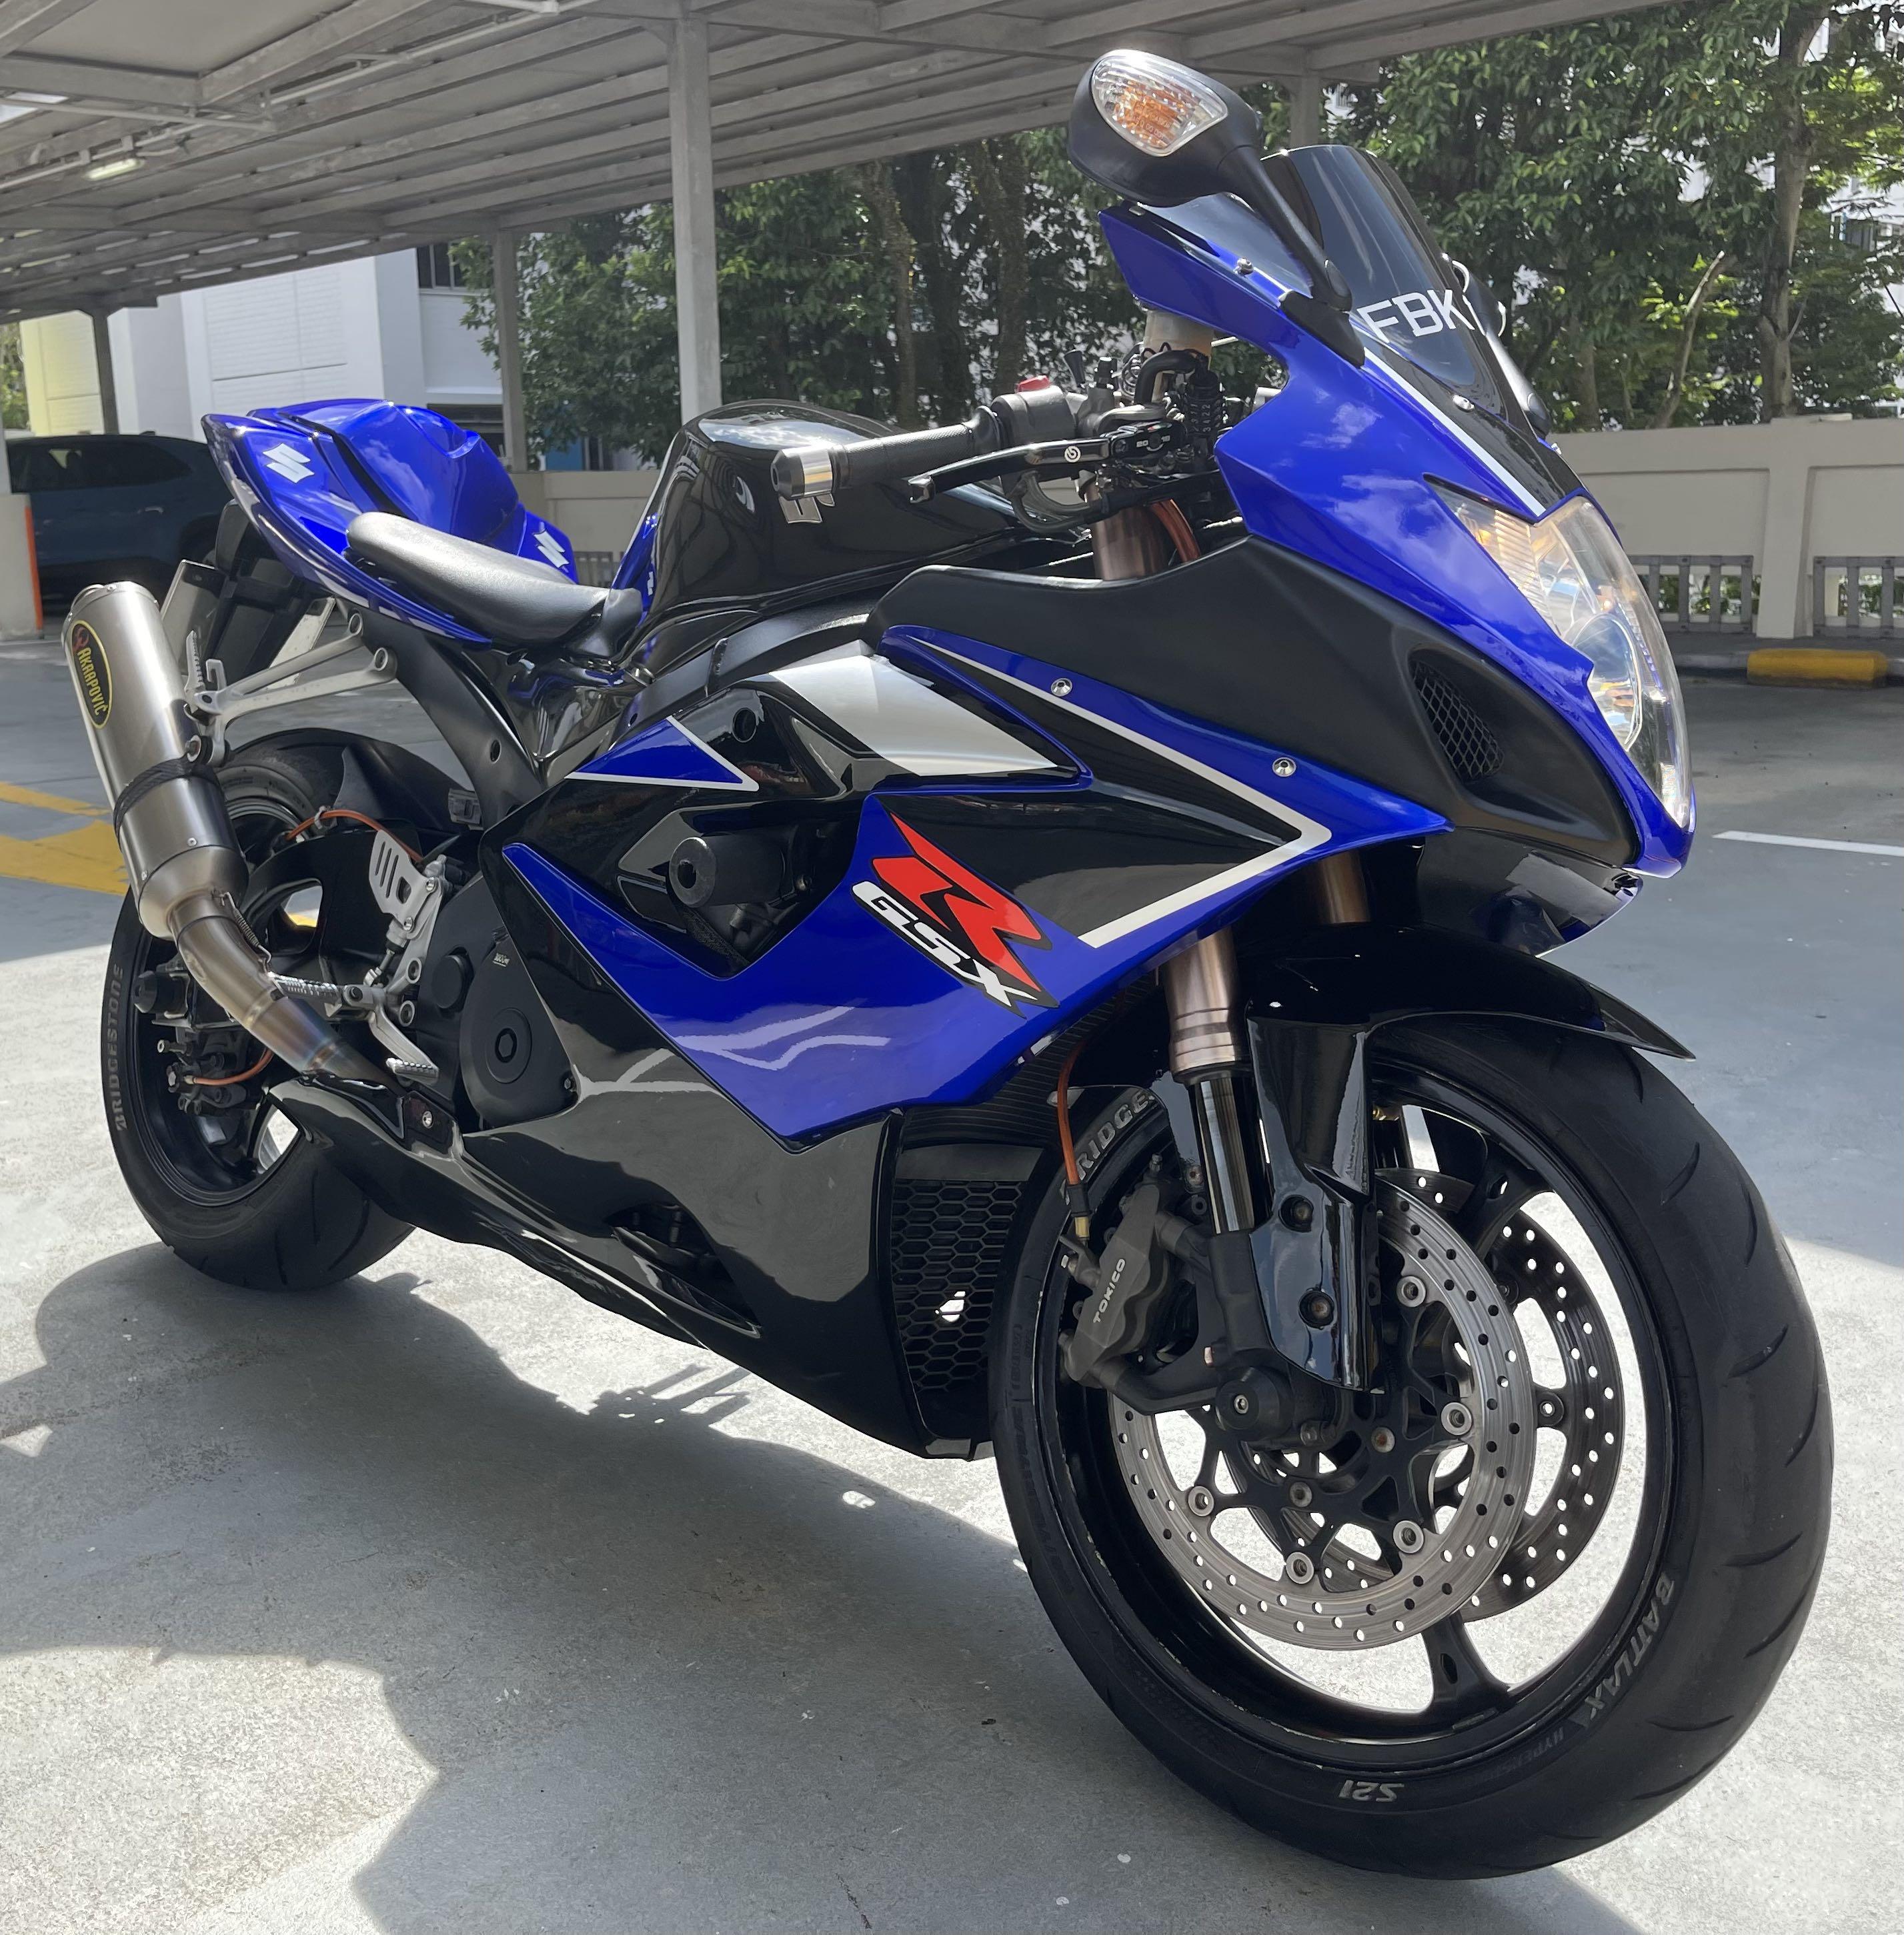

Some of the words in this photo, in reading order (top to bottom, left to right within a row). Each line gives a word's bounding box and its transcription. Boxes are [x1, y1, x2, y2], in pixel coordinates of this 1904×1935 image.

[1356, 289, 1475, 343] FBK
[852, 881, 1038, 1007] GSX
[107, 964, 127, 1131] BRIDGESTONE
[1062, 1089, 1154, 1202] RIDGE
[1093, 1258, 1126, 1324] TOKICO
[1585, 1572, 1675, 1721] BATTLAX
[1338, 1779, 1404, 1802] S21
